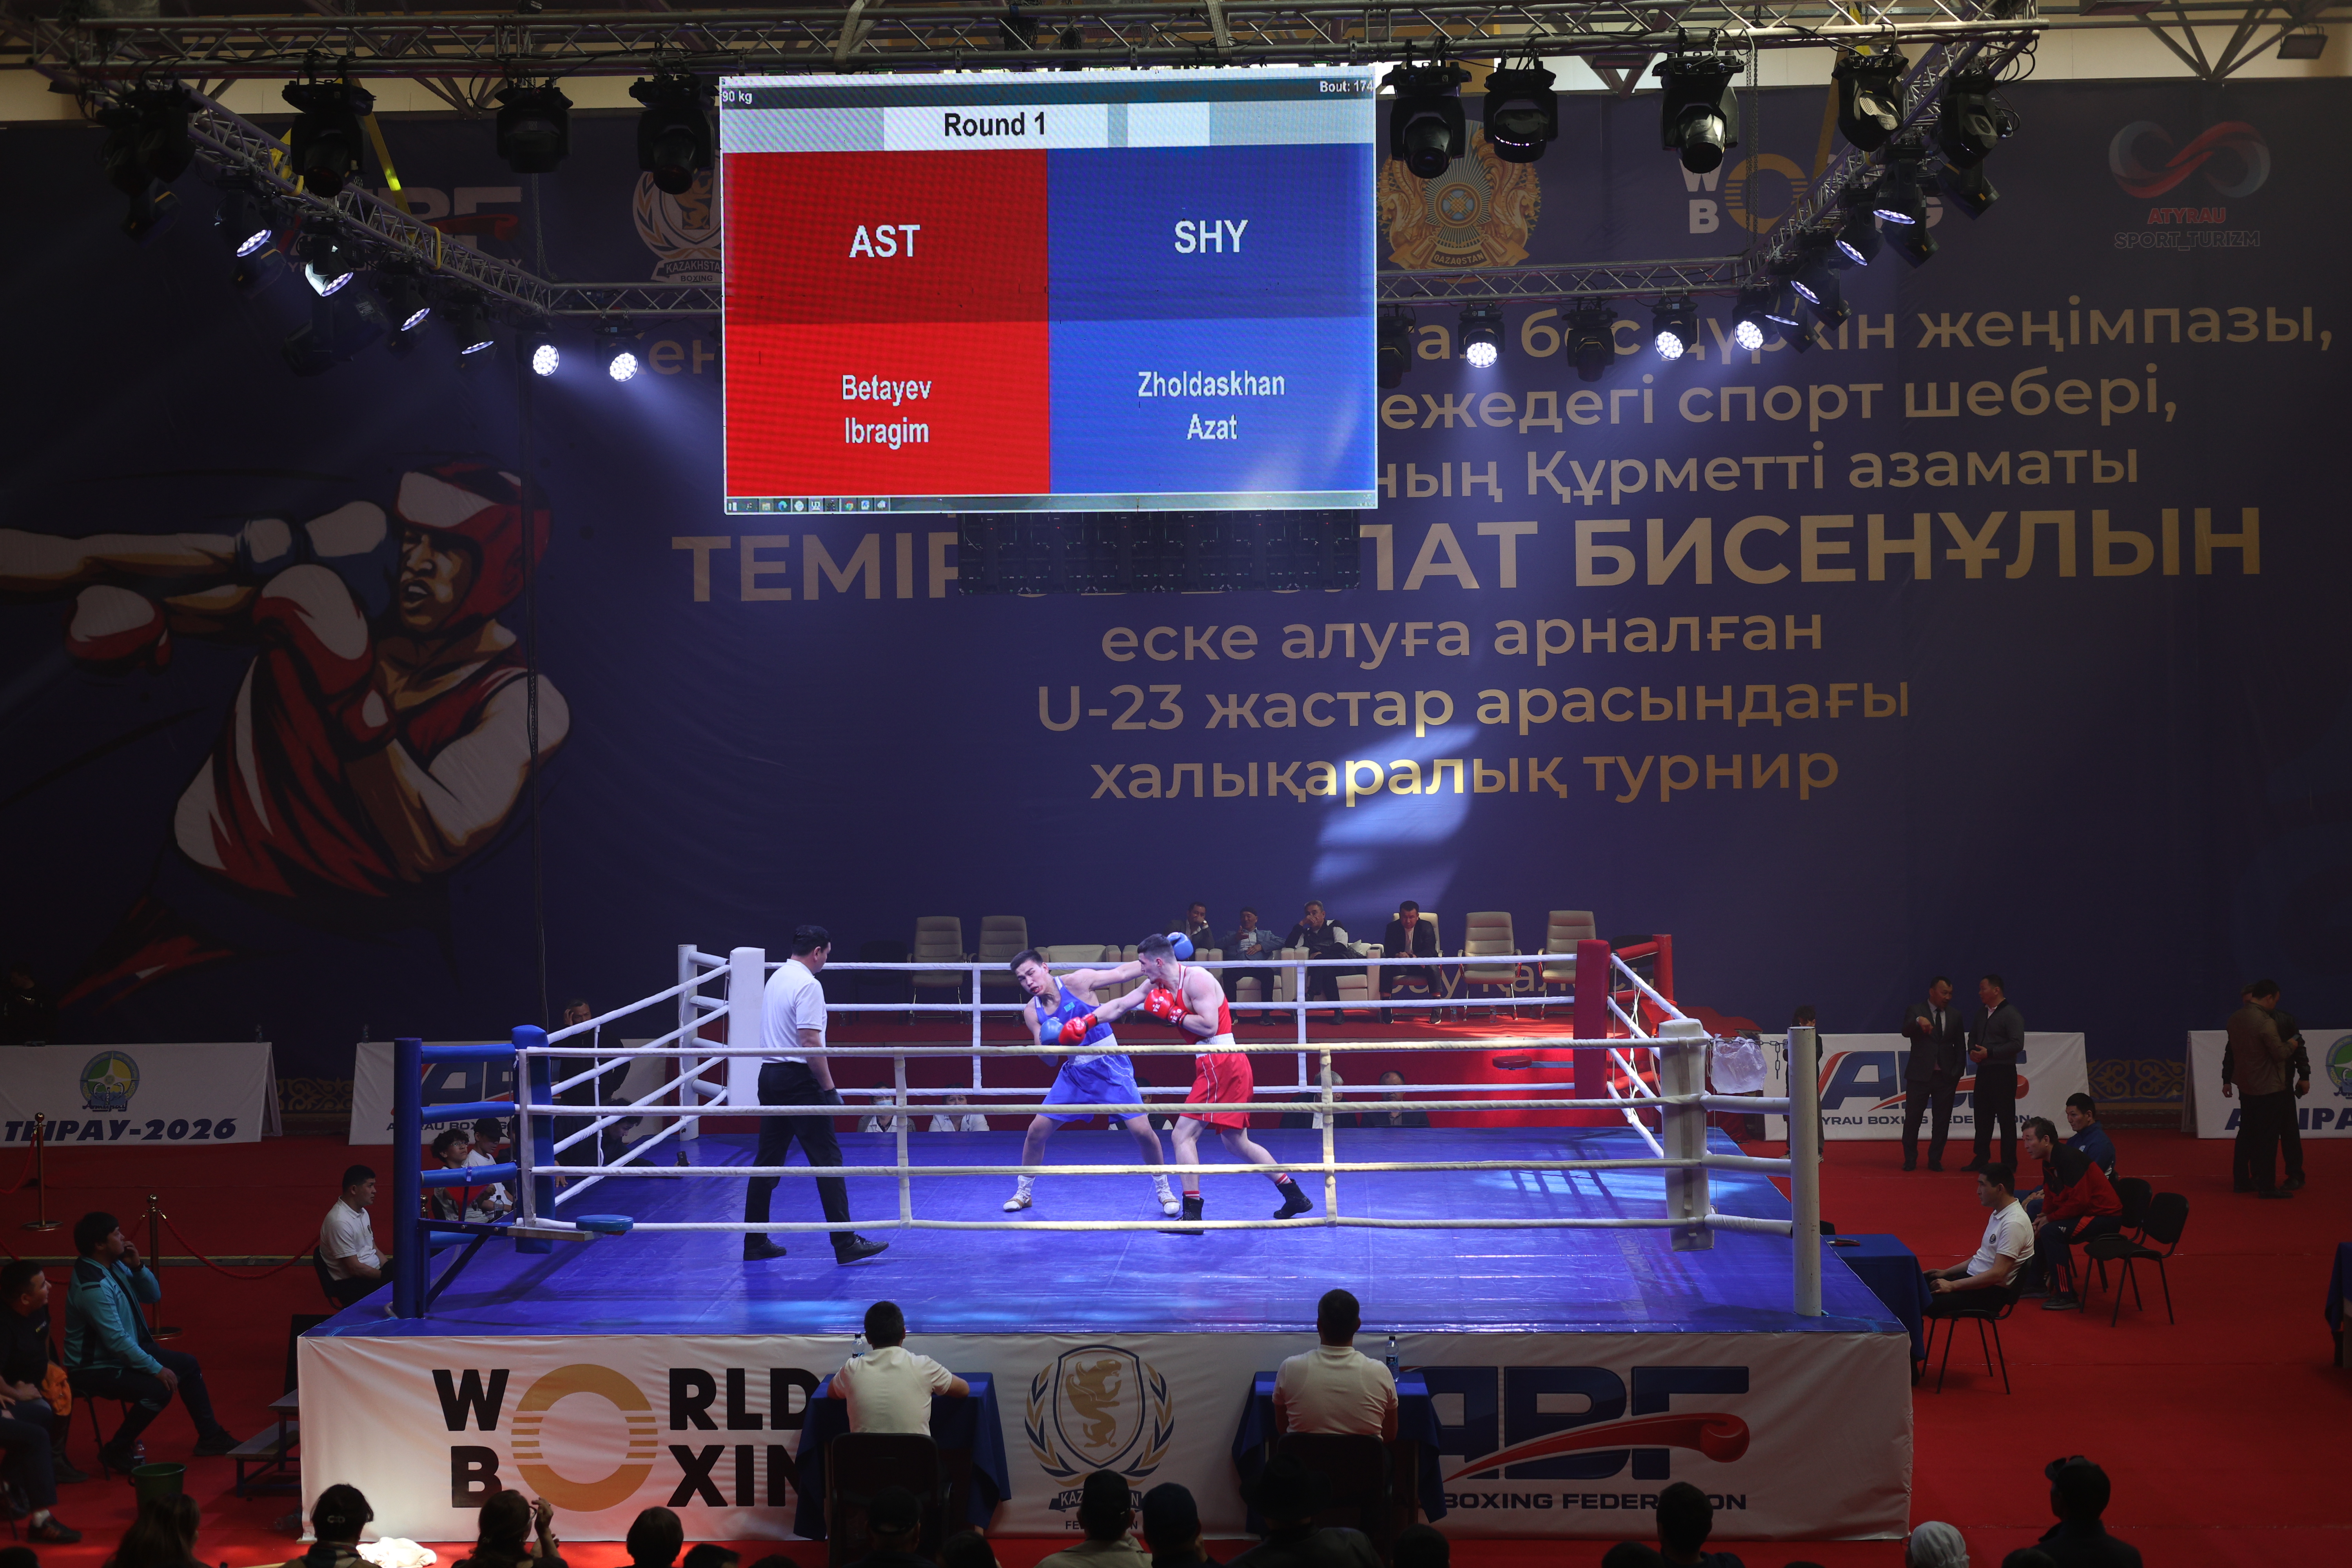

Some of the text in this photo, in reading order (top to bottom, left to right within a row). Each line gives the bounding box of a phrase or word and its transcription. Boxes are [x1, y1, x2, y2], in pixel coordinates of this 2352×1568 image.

[722, 90, 752, 104] 90 kg
[1319, 80, 1350, 92] Bout:
[944, 112, 1045, 136] Round 1
[2147, 207, 2226, 224] ATYRAU
[849, 225, 920, 258] AST
[1175, 220, 1248, 254] SHY
[2114, 230, 2260, 251] SPORT_TURIZM
[1434, 252, 1485, 265] QAZAQSTAN
[1521, 307, 1641, 358] бс
[1917, 295, 2333, 352] жеңімпазы,
[842, 374, 932, 407] Betayev
[1138, 370, 1285, 398] Zholdaskhan
[1679, 382, 1884, 433] спорт
[1904, 363, 2178, 426] шебері,
[845, 417, 929, 450] Ibragim
[1187, 413, 1238, 440] Azat
[1528, 440, 1825, 506] Құрметті
[1849, 448, 2138, 488] азаматы
[1576, 507, 2261, 587] БИСЕНҰЛЫН
[1102, 613, 1822, 670] еске алуға арналған
[1039, 681, 1910, 738] U-23 жастар арасындағы
[1091, 751, 1839, 808] халықаралық турнир
[1868, 1116, 1928, 1124] BOXIG
[1445, 1493, 1746, 1510] BOXING FEDERON
